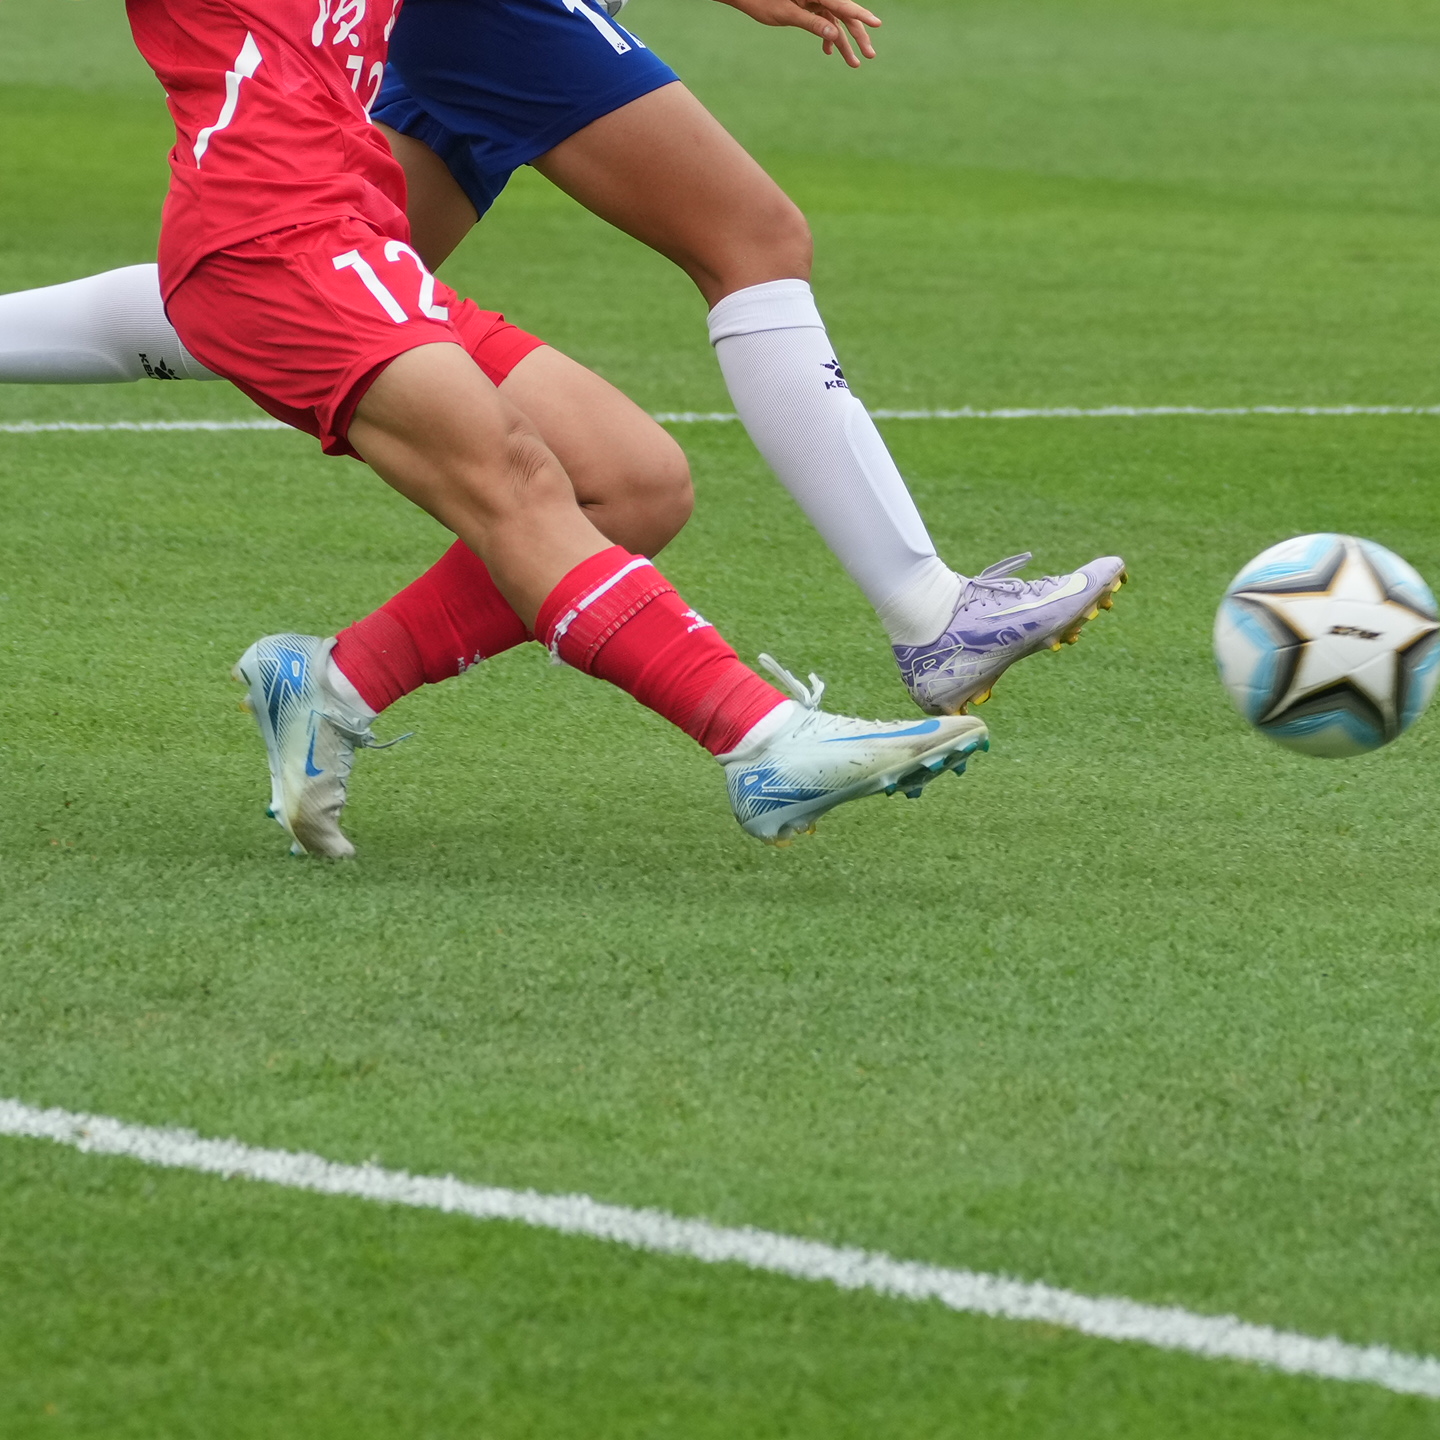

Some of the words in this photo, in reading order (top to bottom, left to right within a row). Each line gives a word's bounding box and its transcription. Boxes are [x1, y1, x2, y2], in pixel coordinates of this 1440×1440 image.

[332, 240, 449, 324] 12
[138, 353, 160, 379] KEL
[825, 380, 849, 390] KEL
